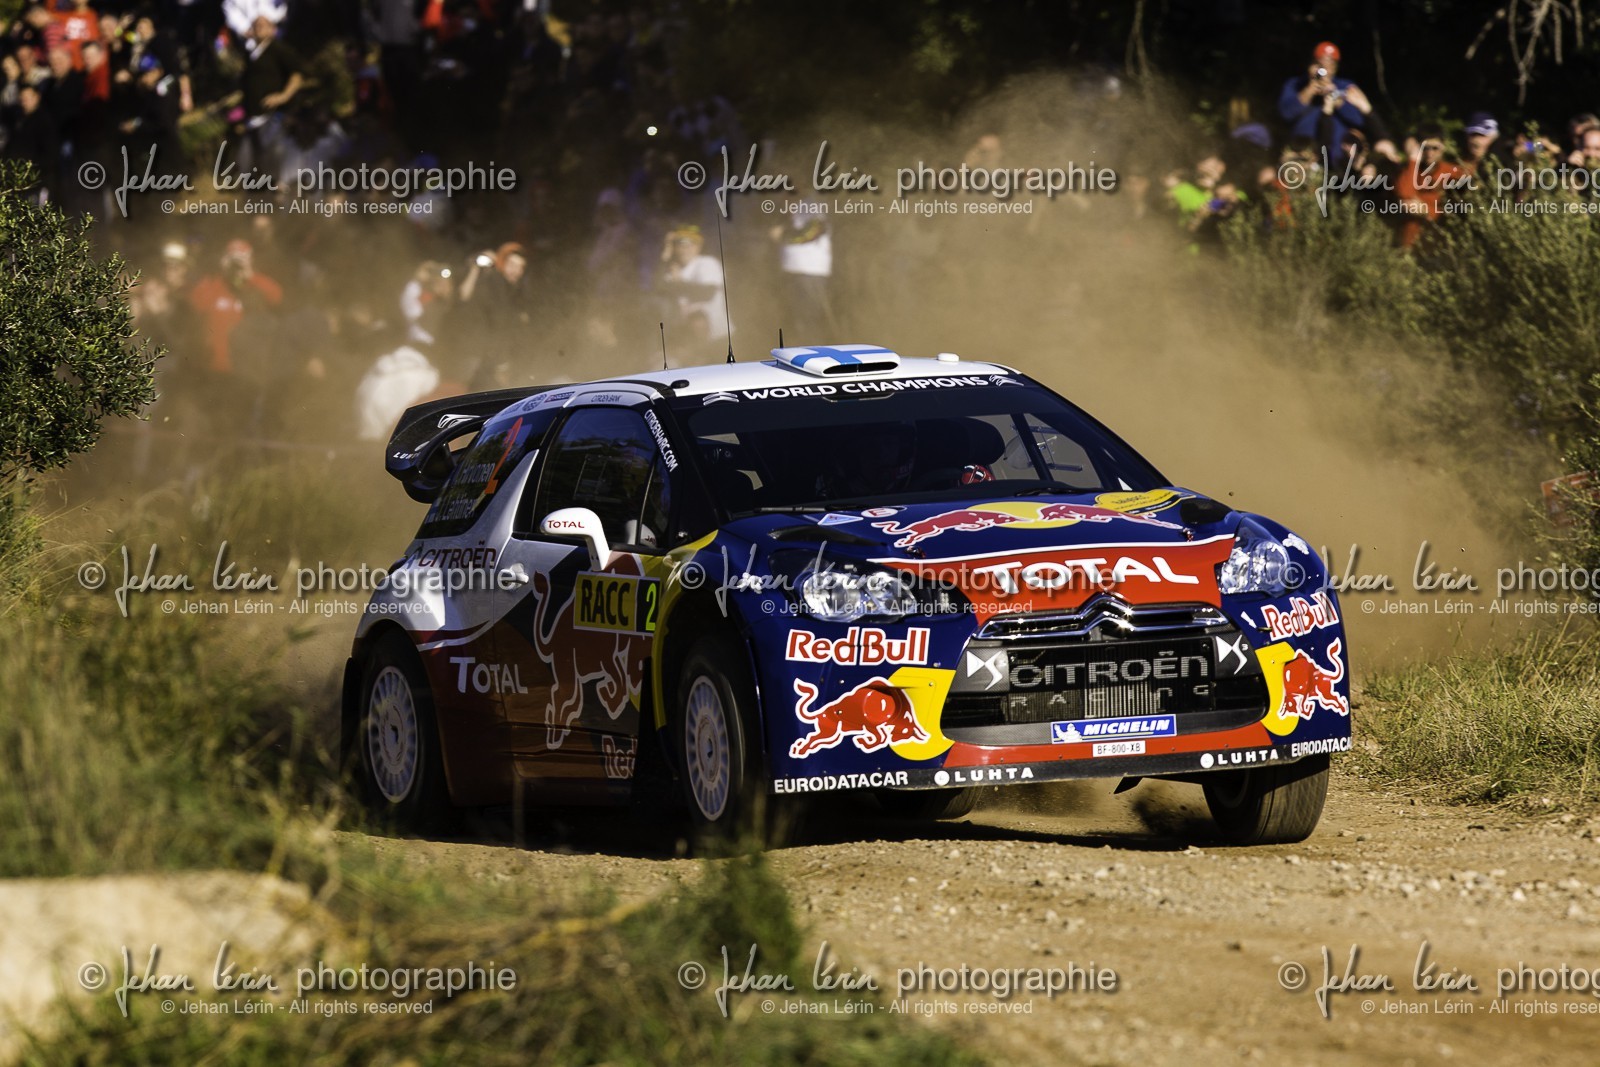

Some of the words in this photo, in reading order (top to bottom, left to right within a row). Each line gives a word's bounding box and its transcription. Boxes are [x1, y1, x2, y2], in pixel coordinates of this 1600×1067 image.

[742, 384, 838, 401] WORLD
[841, 376, 990, 394] CHAMPIONS
[546, 518, 586, 530] TOTAL
[973, 556, 1200, 595] TOTAL
[579, 579, 630, 627] RACC
[644, 582, 657, 631] 2
[449, 656, 528, 694] TOTAL
[1084, 720, 1170, 736] MICHELIN
[1097, 743, 1141, 755] BF-800-XB
[1218, 749, 1279, 765] LUHTA
[774, 771, 908, 793] EURODATACAR
[955, 767, 1034, 782] LUHTA
